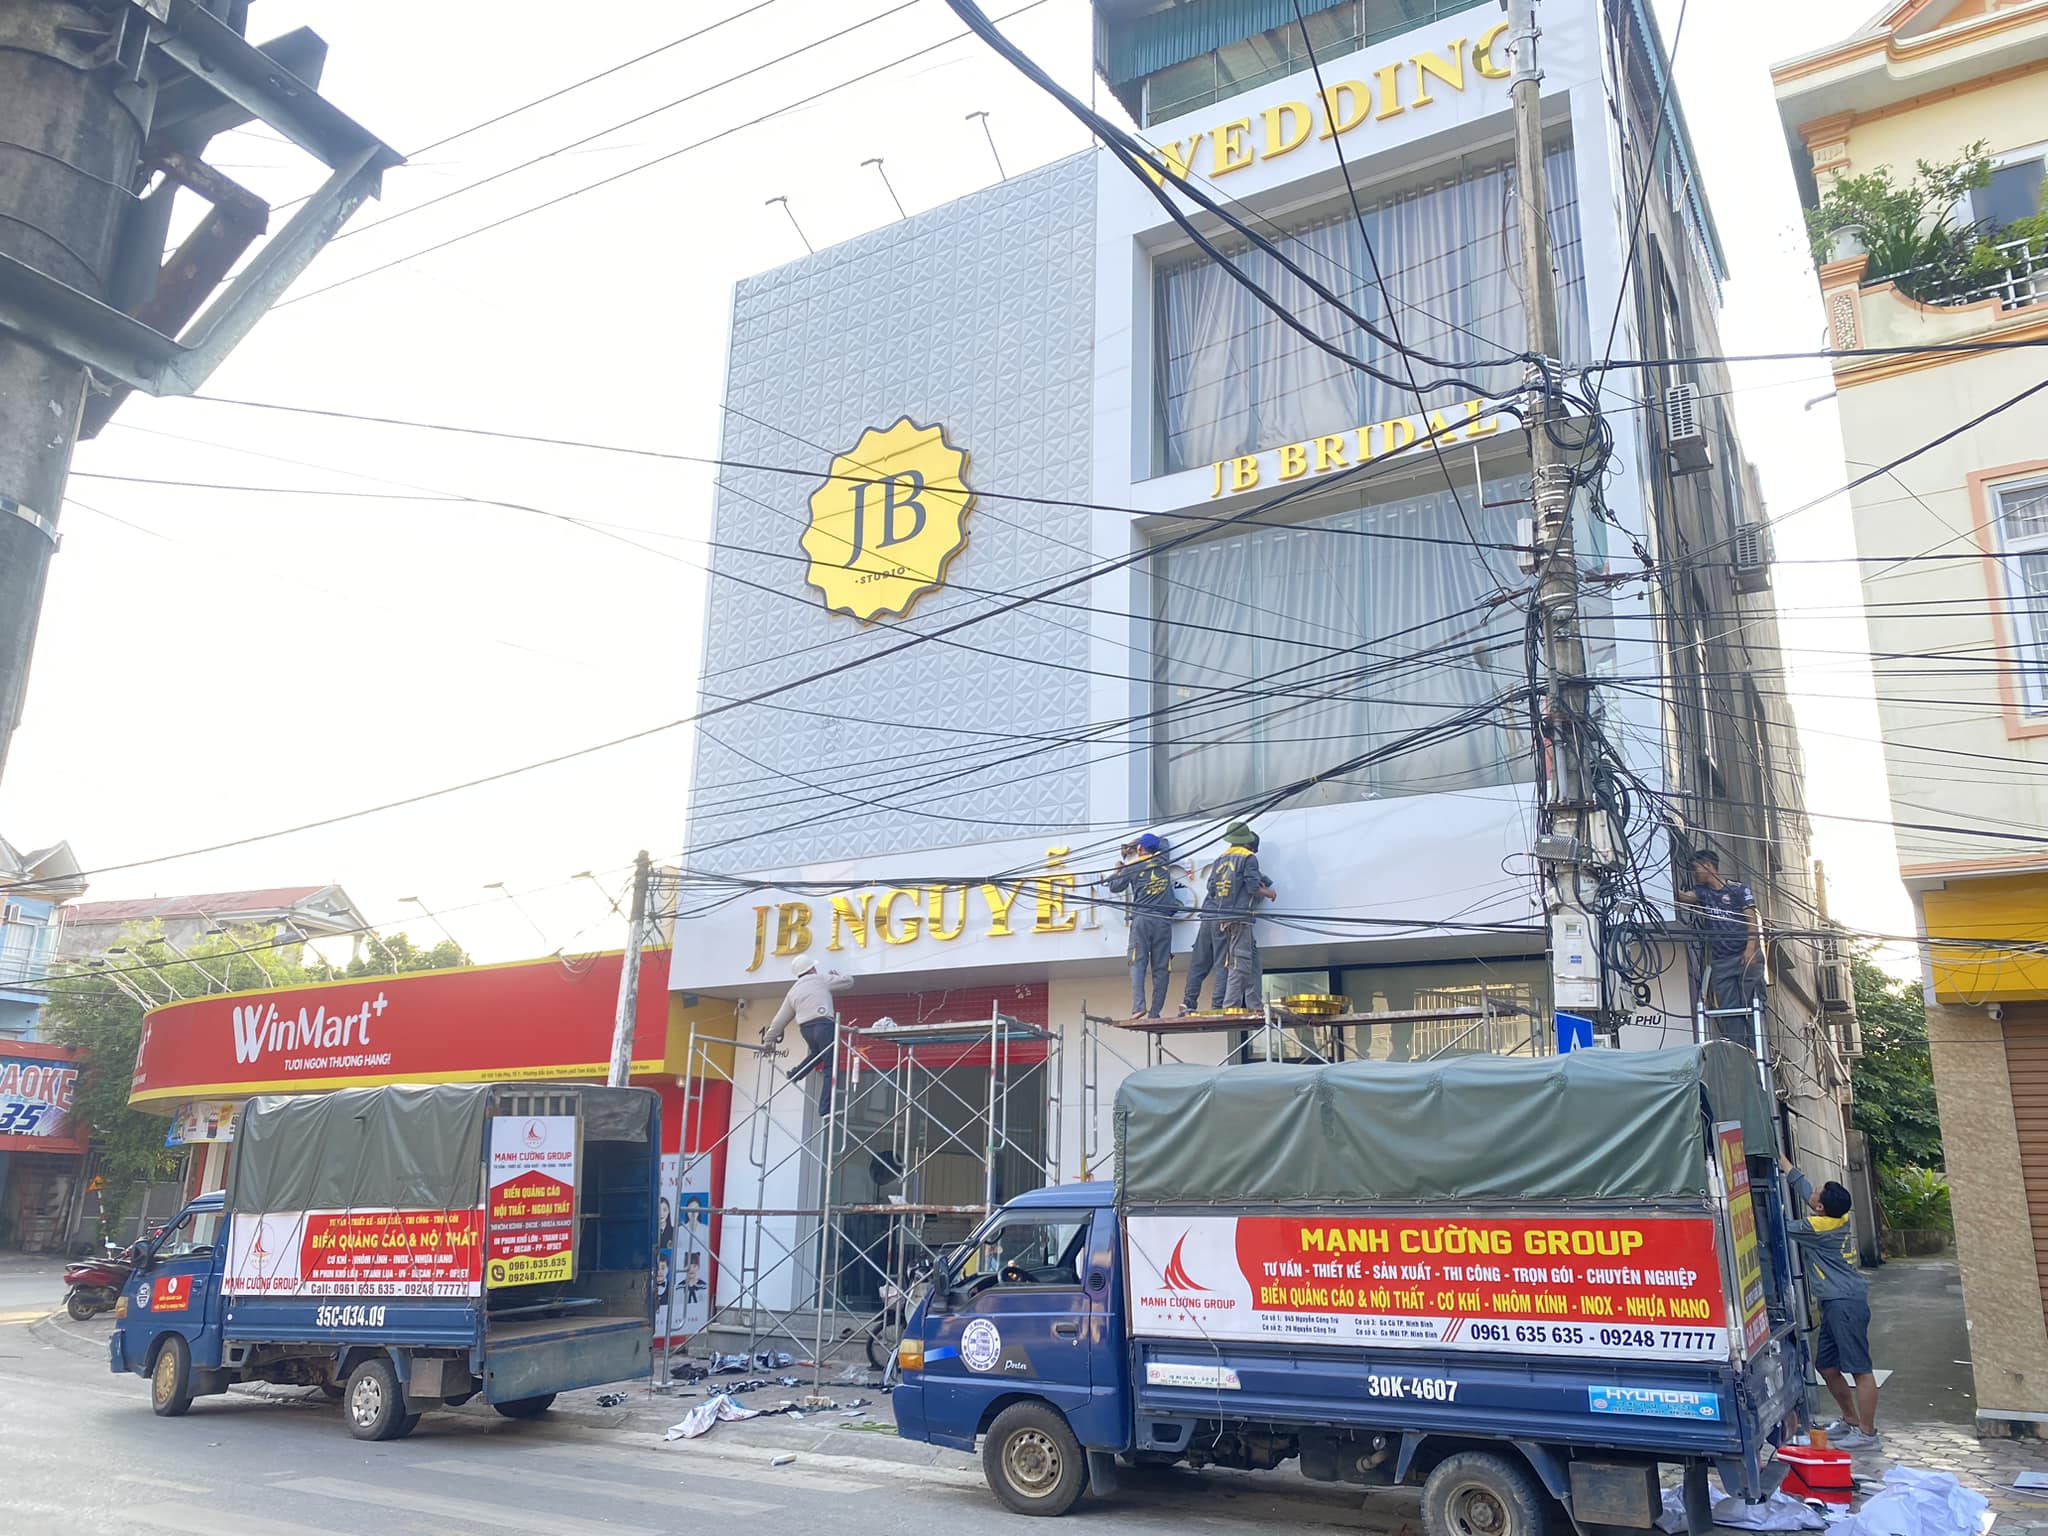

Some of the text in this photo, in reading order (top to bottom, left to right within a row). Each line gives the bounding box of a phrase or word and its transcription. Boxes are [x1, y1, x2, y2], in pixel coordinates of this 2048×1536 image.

[1211, 398, 1498, 498] JB BRIDAL
[843, 470, 926, 569] JB
[746, 902, 813, 973] JB
[304, 1057, 328, 1070] NGON
[0, 1063, 78, 1112] AOKE
[547, 1151, 572, 1160] GROUP
[409, 1232, 416, 1247] &
[1301, 1224, 1643, 1257] MẠNH CƯỜNG GROUP
[273, 1277, 299, 1290] GROUP
[1263, 1258, 1698, 1289] TƯ VẤN THIẾT KẾ SẢN XUẤT THI CÔNG TRỌN GÓI CHUYÊN NGHIỆP
[311, 1284, 331, 1295] Call:
[334, 1284, 354, 1295] 0961
[1140, 1295, 1236, 1310] MẠNH CƯỜNG GROUP
[1260, 1278, 1710, 1321] BIỂN QUẢNG CÁO & NỘI THẤT CƠ KHÍ NHÔM KÍNH INOX NHỰA NANO
[316, 1306, 386, 1328] 35C-034.09
[1470, 1324, 1716, 1350] 0961 635 635 09248 77777
[1368, 1375, 1458, 1402] 30K-4607
[1606, 1388, 1700, 1405] HYUNDAI
